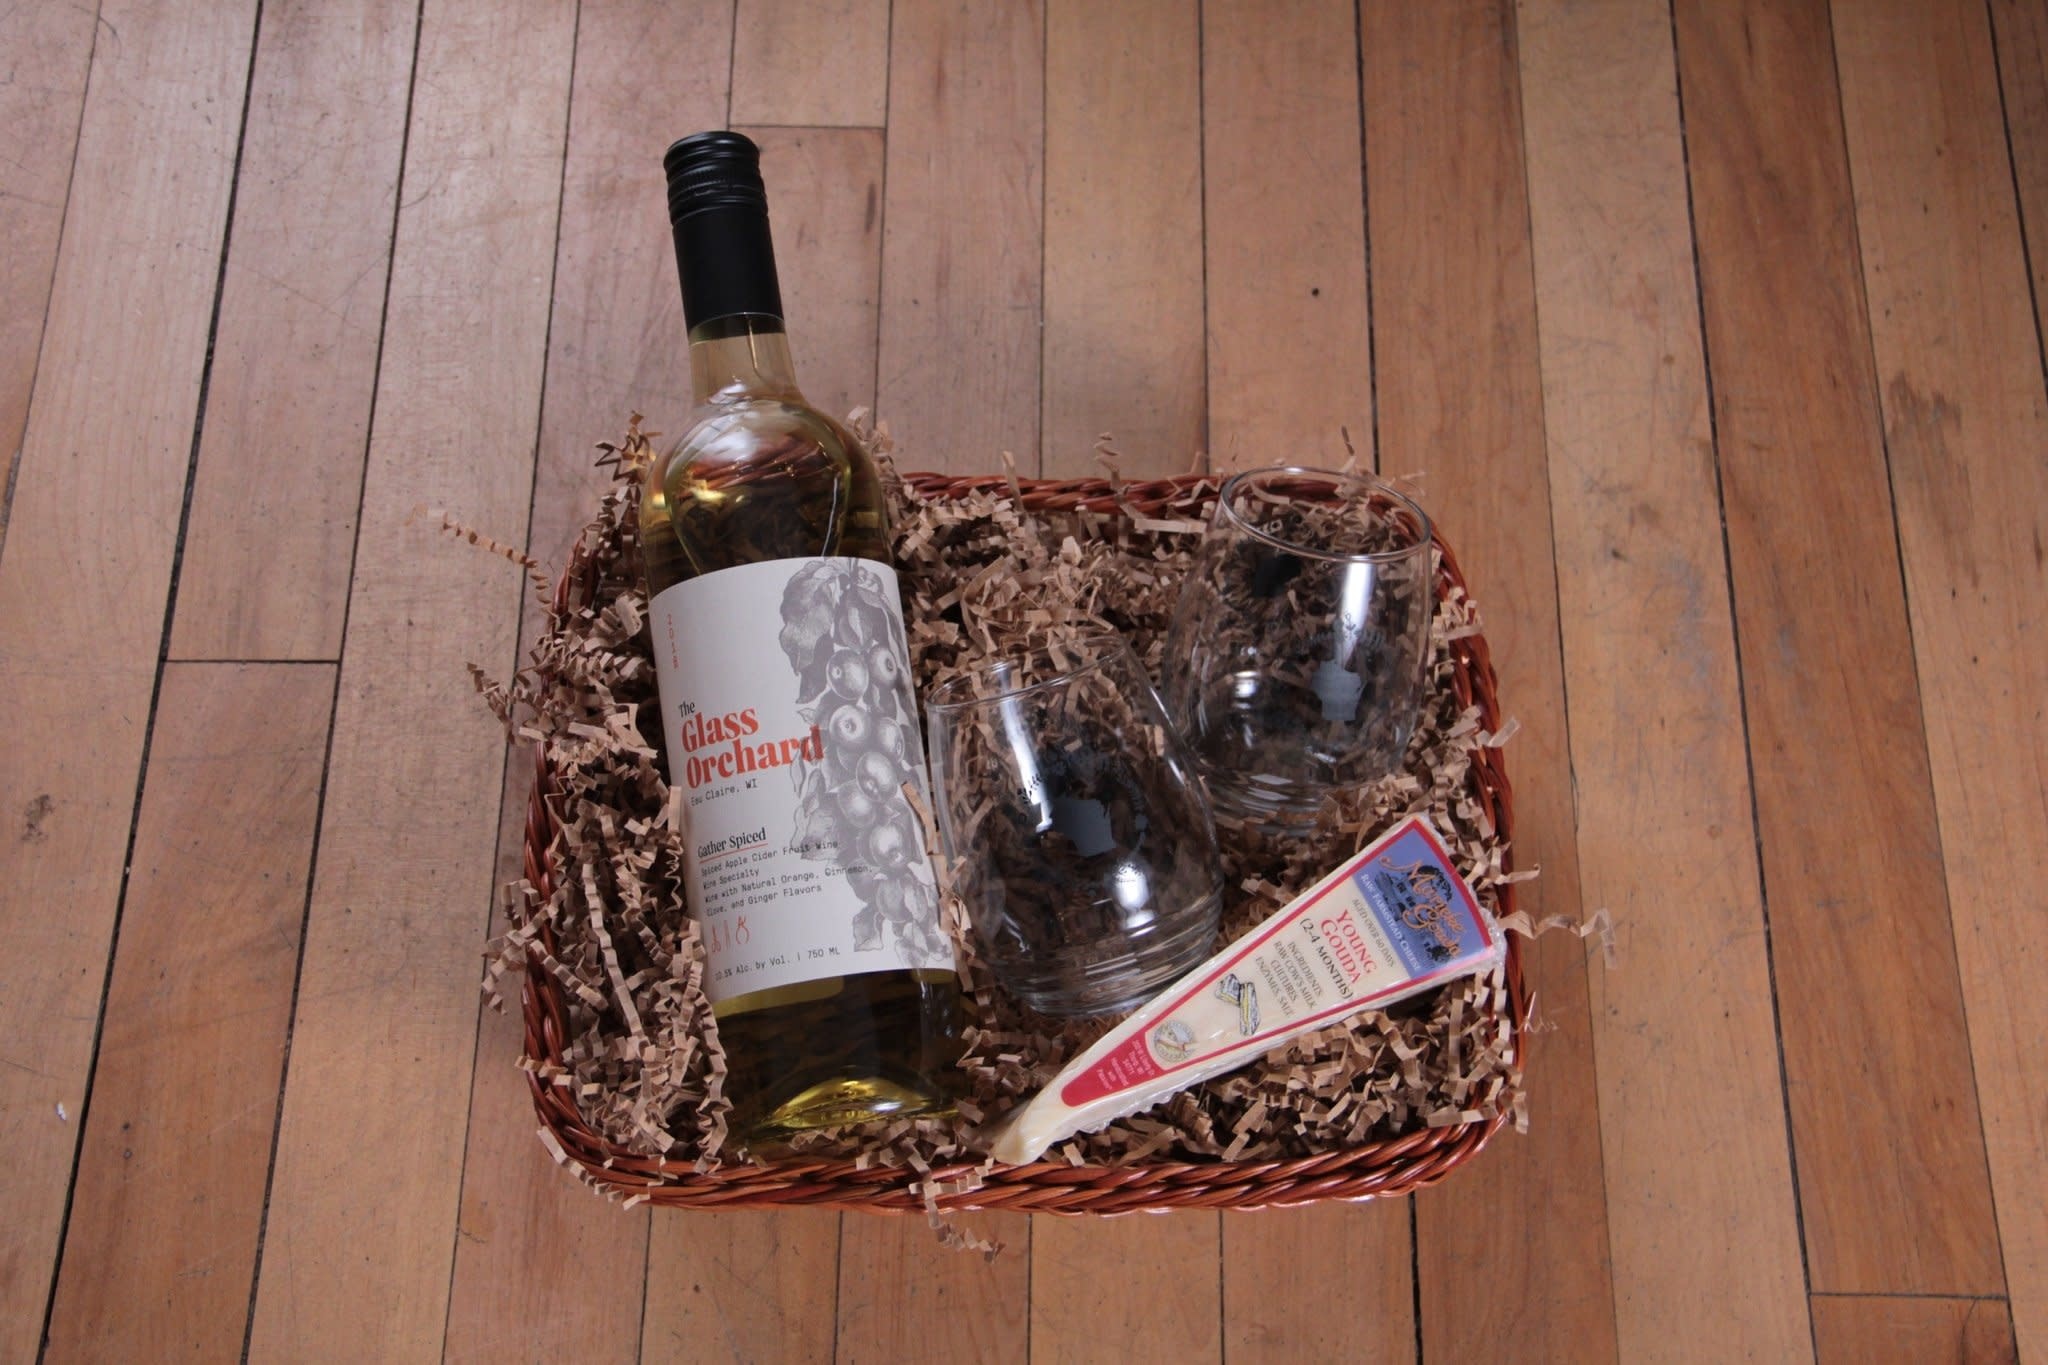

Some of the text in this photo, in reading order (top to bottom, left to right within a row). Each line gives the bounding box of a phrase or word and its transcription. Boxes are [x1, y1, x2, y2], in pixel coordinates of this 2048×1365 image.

[678, 701, 695, 717] The
[682, 708, 759, 752] Glass
[686, 723, 824, 789] Orchard
[745, 779, 757, 789] WI
[697, 827, 766, 858] Gather Spiced
[702, 841, 838, 877] Spiced Apple Cider Fruit Wine
[720, 868, 759, 885] Specialty
[722, 887, 738, 897] with
[741, 877, 776, 892] Natural
[731, 899, 745, 909] and
[748, 891, 778, 905] Ginger
[783, 885, 822, 896] Flavors
[1273, 941, 1287, 959] RAW
[1320, 918, 1361, 985] GOUDA
[1336, 909, 1378, 975] YOUNG
[736, 964, 752, 974] Alc.
[755, 961, 765, 969] by
[769, 955, 790, 966] Vol.
[807, 949, 824, 960] 750
[828, 946, 840, 956] ML
[1300, 917, 1353, 1000] (2-4 MONTHS)
